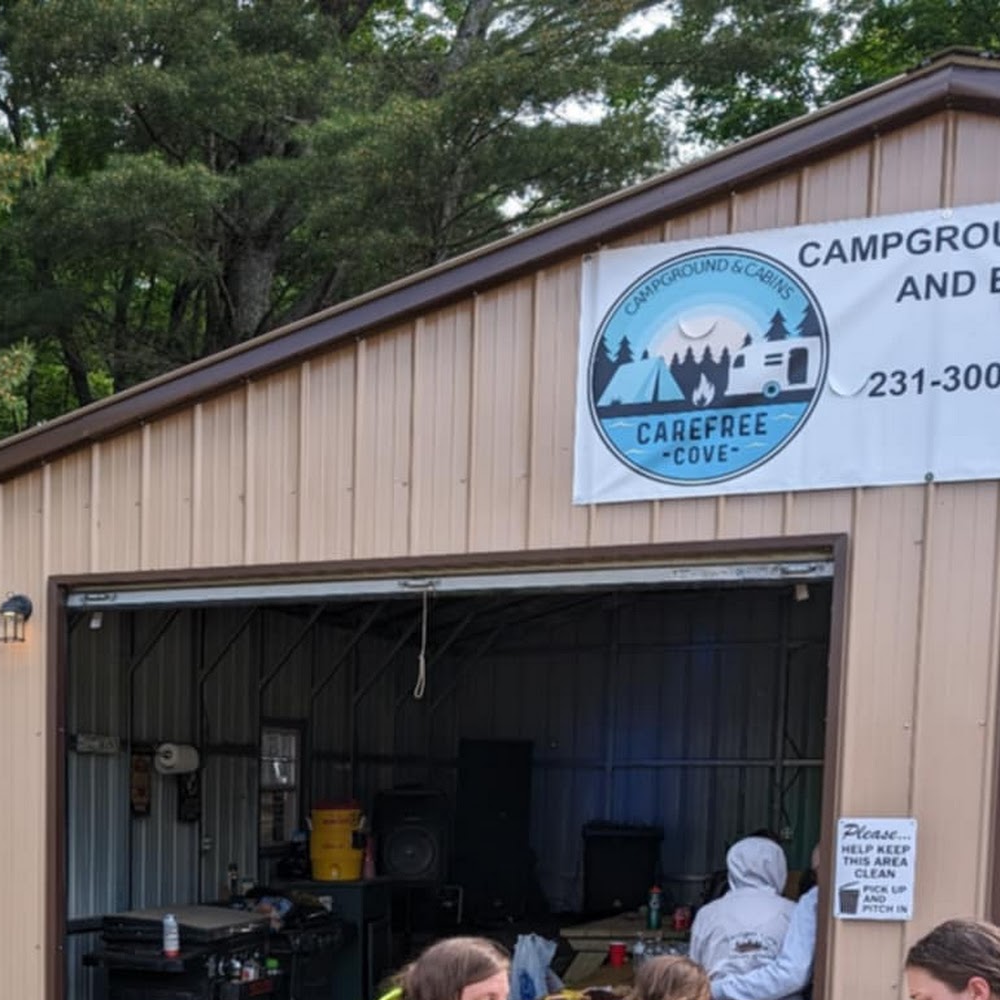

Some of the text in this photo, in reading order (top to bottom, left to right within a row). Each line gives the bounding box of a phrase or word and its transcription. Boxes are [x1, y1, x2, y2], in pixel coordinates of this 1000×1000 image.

[798, 221, 1000, 267] CAMPGRO
[624, 258, 728, 315] CAMPGROUND
[744, 262, 795, 301] CABINS
[896, 270, 976, 303] AND
[868, 362, 1000, 397] 231-300
[636, 412, 768, 445] CAREFREE
[841, 845, 911, 855] HELP KEEP
[843, 857, 908, 867] THIS AREA
[854, 869, 896, 878] CLEAN
[862, 885, 907, 894] PICK UP
[862, 895, 886, 903] AND
[862, 905, 908, 913] PITCH IN
